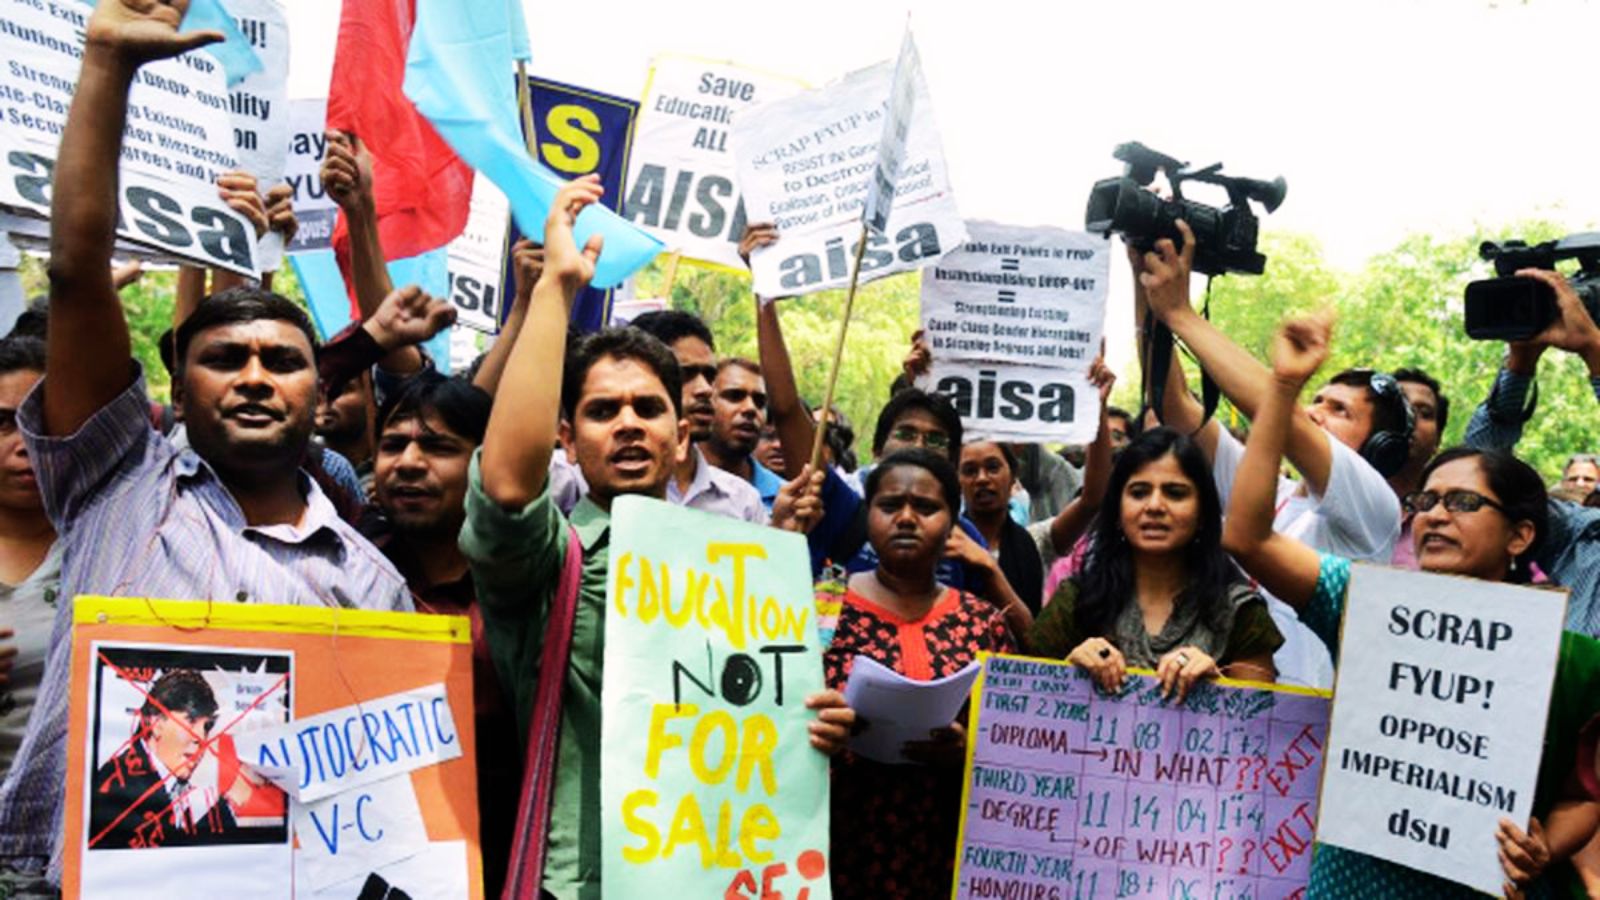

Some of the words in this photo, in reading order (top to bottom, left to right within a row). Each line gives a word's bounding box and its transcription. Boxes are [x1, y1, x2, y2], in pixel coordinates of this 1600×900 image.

[698, 72, 755, 102] Save
[541, 104, 602, 174] S
[692, 127, 728, 153] ALL
[779, 222, 942, 289] aisa
[937, 370, 1076, 424] aisa
[1387, 604, 1514, 652] SCRAP
[672, 639, 808, 713] NOT
[1388, 661, 1495, 710] FYUP!
[643, 703, 779, 797] FOR
[1379, 714, 1491, 760] OPPOSE
[973, 766, 1027, 794] THIRD
[1033, 773, 1078, 799] YEAR
[1155, 753, 1230, 786] WHAT
[1340, 748, 1517, 813] IMPERIALISM
[310, 794, 384, 856] V-C
[1387, 808, 1450, 850] dsu
[1137, 838, 1212, 867] WHAT
